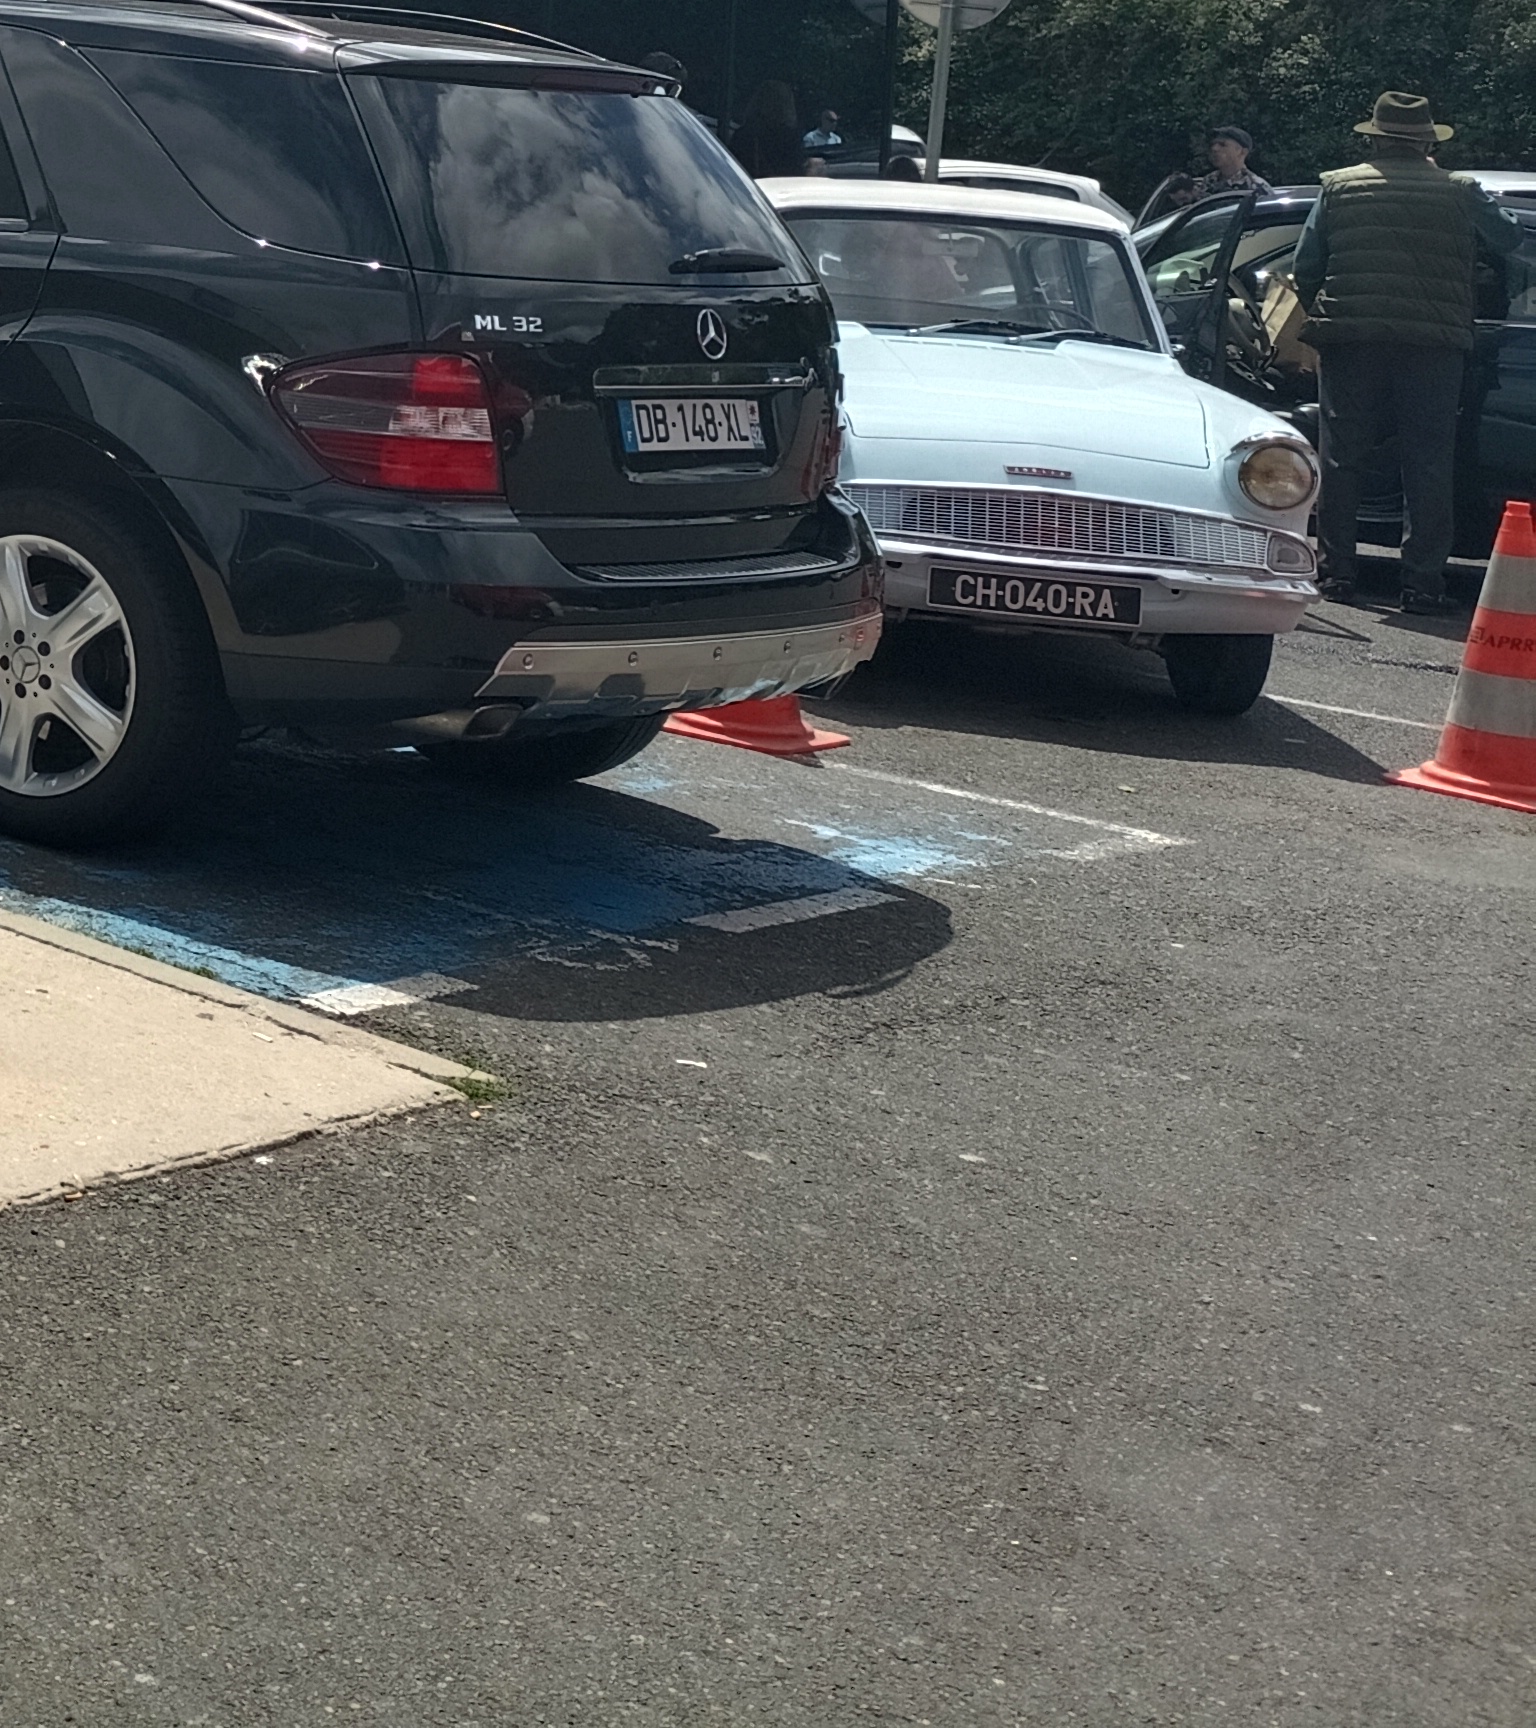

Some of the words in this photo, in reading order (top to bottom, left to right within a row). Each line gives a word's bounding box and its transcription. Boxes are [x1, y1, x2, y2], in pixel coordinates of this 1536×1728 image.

[474, 315, 507, 330] ML
[512, 317, 543, 332] 32
[954, 574, 1115, 619] CH-040-RA
[1483, 633, 1535, 652] APRR
